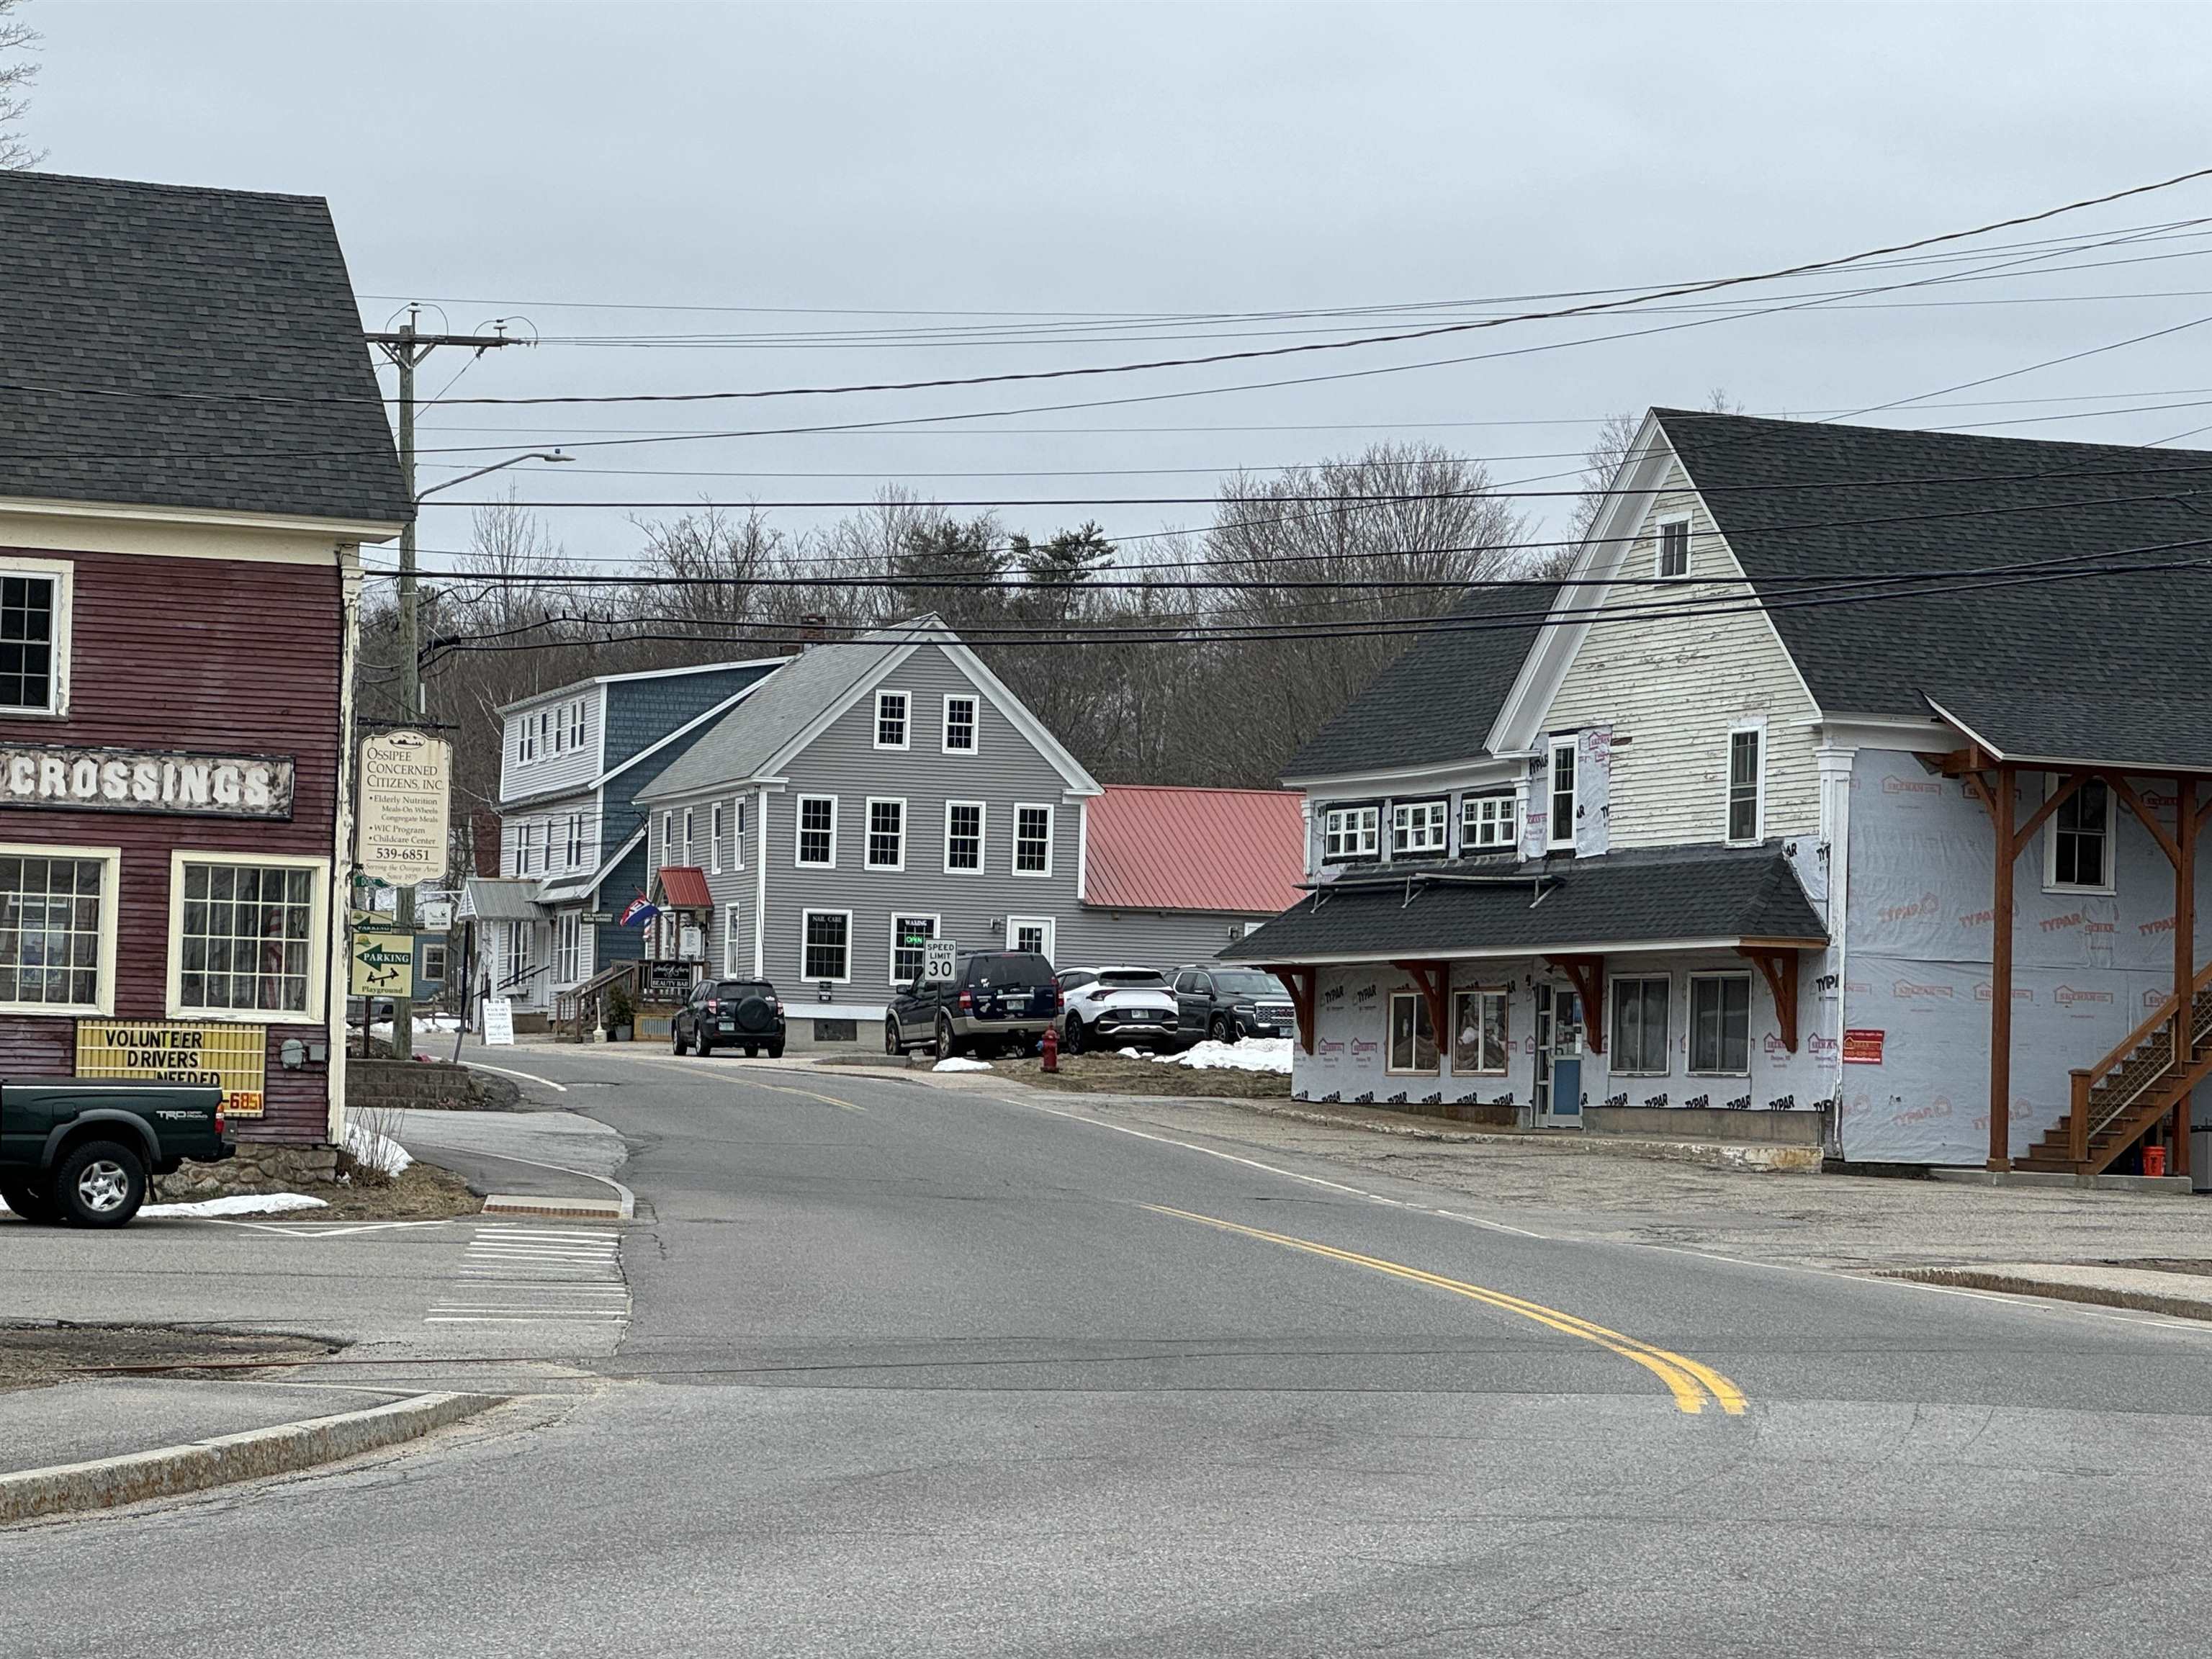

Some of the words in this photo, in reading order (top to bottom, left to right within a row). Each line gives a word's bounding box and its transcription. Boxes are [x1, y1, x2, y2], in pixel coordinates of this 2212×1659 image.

[367, 747, 412, 762] OSSIPEE
[367, 760, 438, 776] CONCERNED
[9, 755, 269, 806] CROSSINGS
[367, 774, 420, 790] CITIZENS,
[374, 795, 400, 804] Elderly
[403, 796, 437, 805] Nutrition
[382, 814, 418, 823] Congregate
[393, 825, 425, 835] Program
[376, 848, 429, 860] 539-6851
[2039, 912, 2081, 932] TYPAR
[364, 953, 409, 963] PARKING
[928, 961, 952, 976] 30
[1325, 986, 1344, 1003] TYPAR
[1357, 984, 1377, 1002] TYPAR
[106, 1030, 202, 1048] VOLUNTEER
[127, 1051, 199, 1068] DRIVERS
[1645, 1093, 1668, 1107] TYPAR
[1685, 1094, 1709, 1109] TYPAR
[1727, 1094, 1750, 1110] TYPAR
[1769, 1094, 1794, 1111] TYPAR
[156, 1110, 186, 1120] TRD
